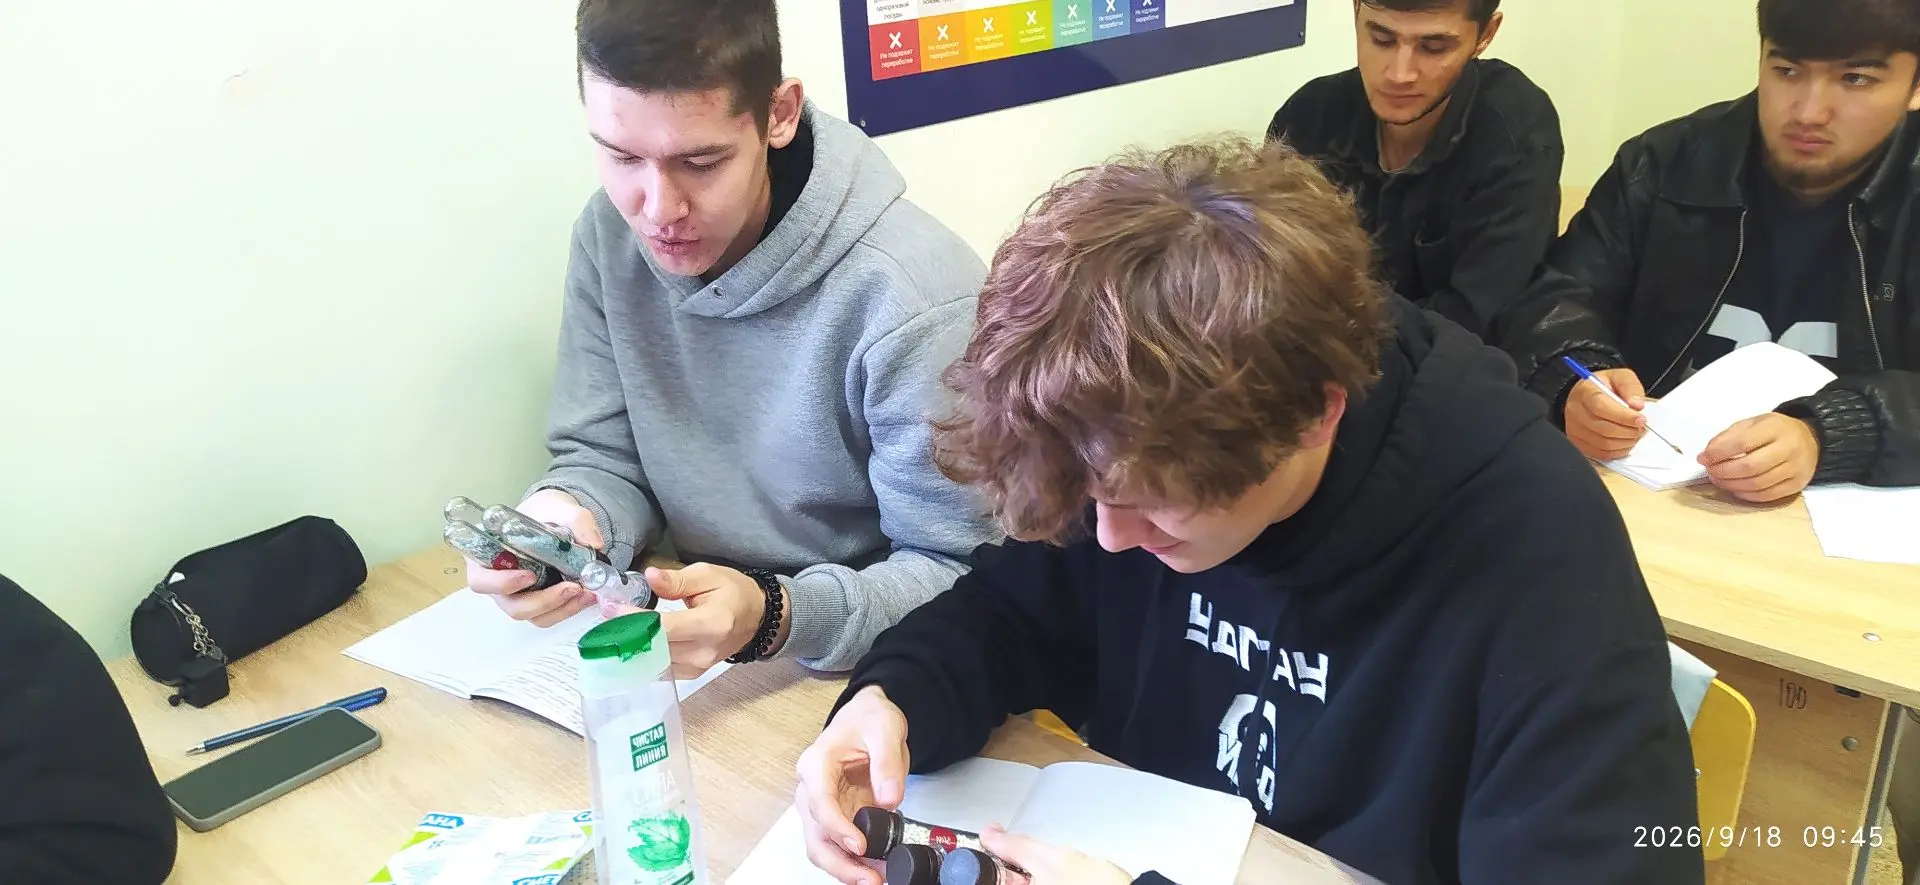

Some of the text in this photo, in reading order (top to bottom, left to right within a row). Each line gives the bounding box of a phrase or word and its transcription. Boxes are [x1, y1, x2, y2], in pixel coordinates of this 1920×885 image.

[888, 49, 913, 59] подлежит
[881, 58, 913, 69] переработке
[633, 725, 664, 748] ЧИСТАЯ
[636, 744, 667, 768] ЛИНИЯ
